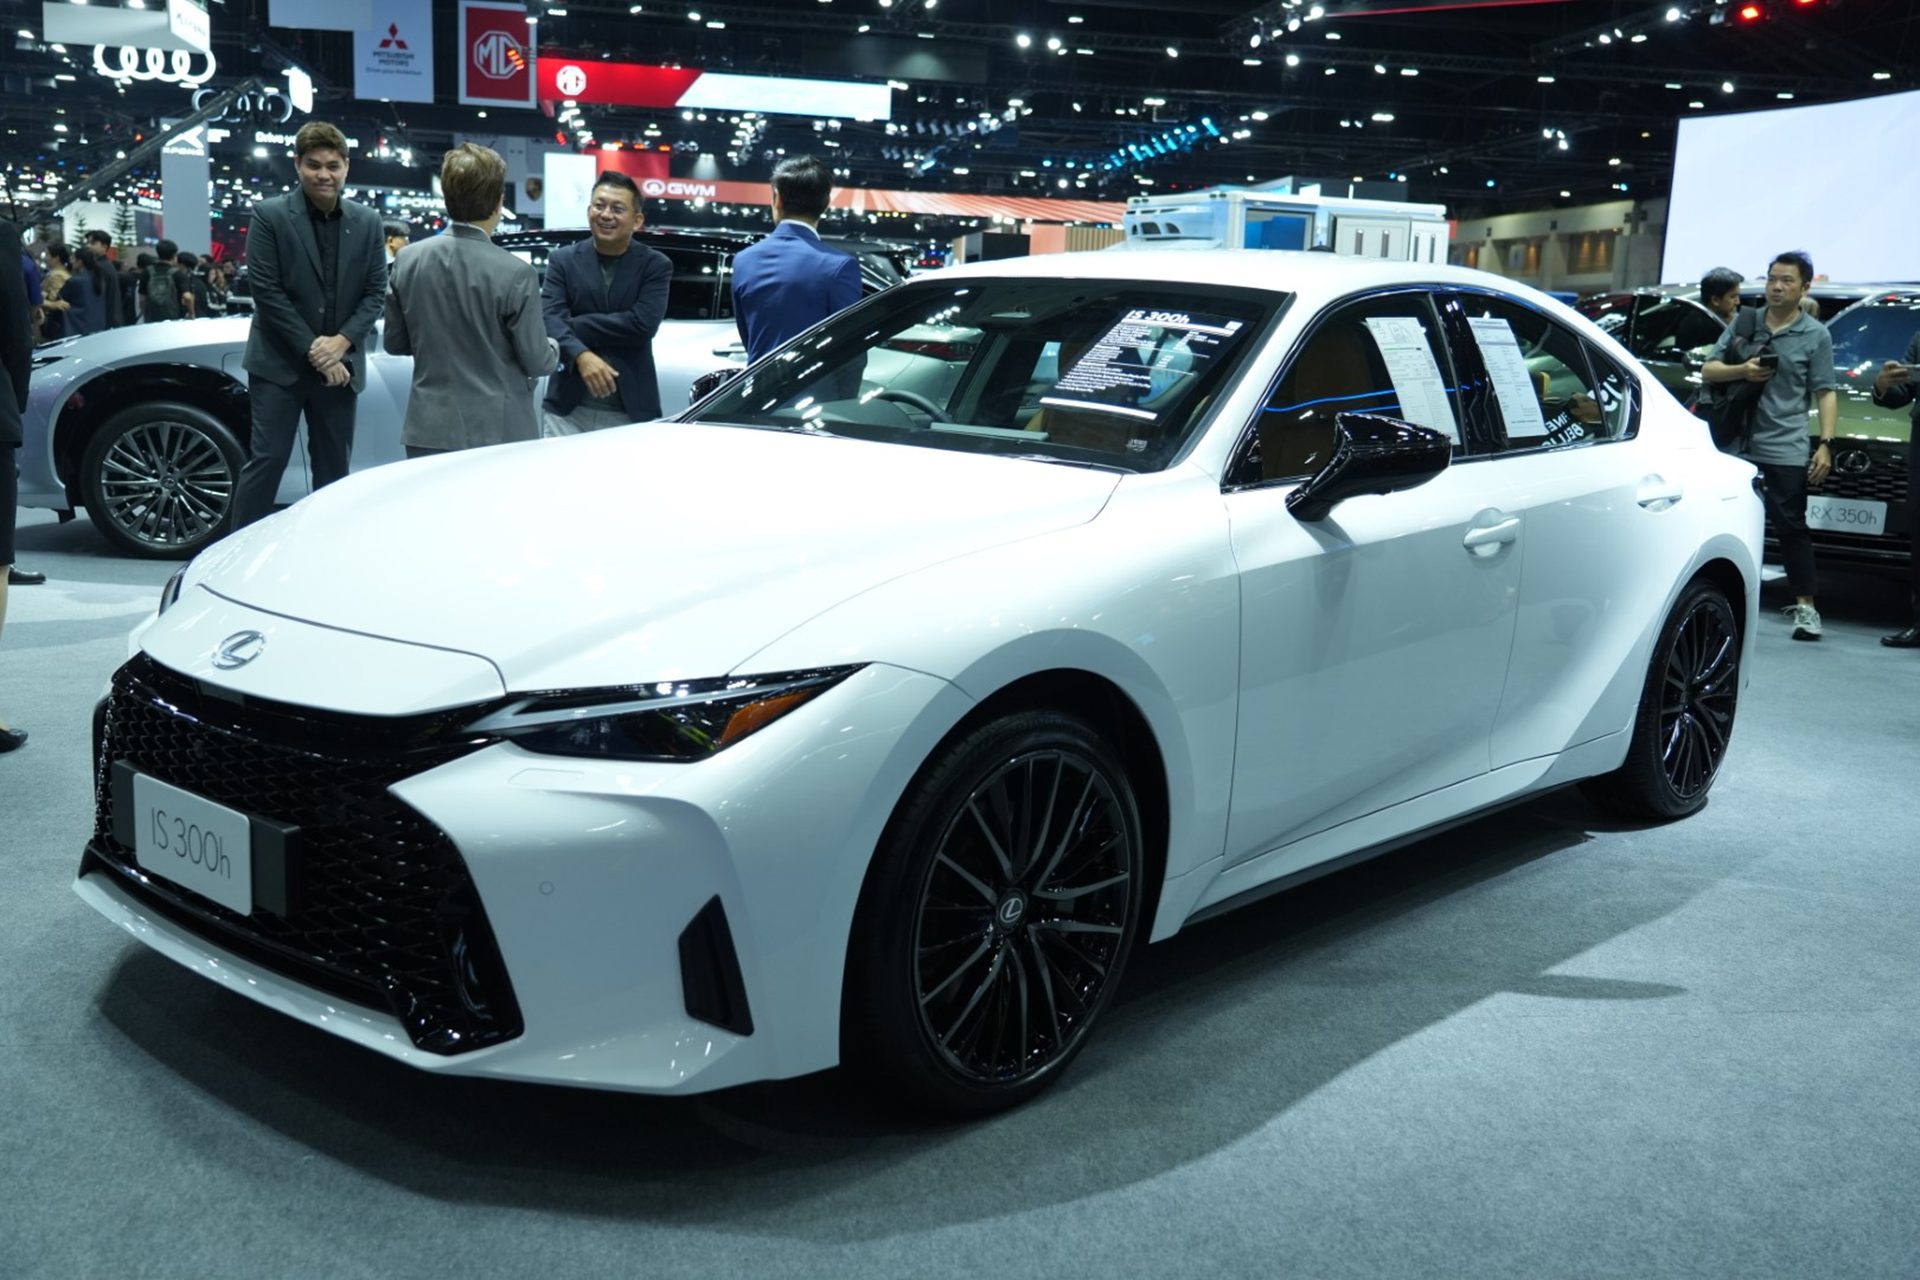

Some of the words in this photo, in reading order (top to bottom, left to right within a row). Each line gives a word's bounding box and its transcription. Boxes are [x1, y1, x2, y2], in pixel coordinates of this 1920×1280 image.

[667, 182, 716, 197] GWM
[1145, 311, 1190, 324] 300h
[1810, 505, 1832, 521] RX
[1836, 507, 1877, 526] 350h
[152, 808, 169, 850] IS
[174, 817, 231, 880] 300h
